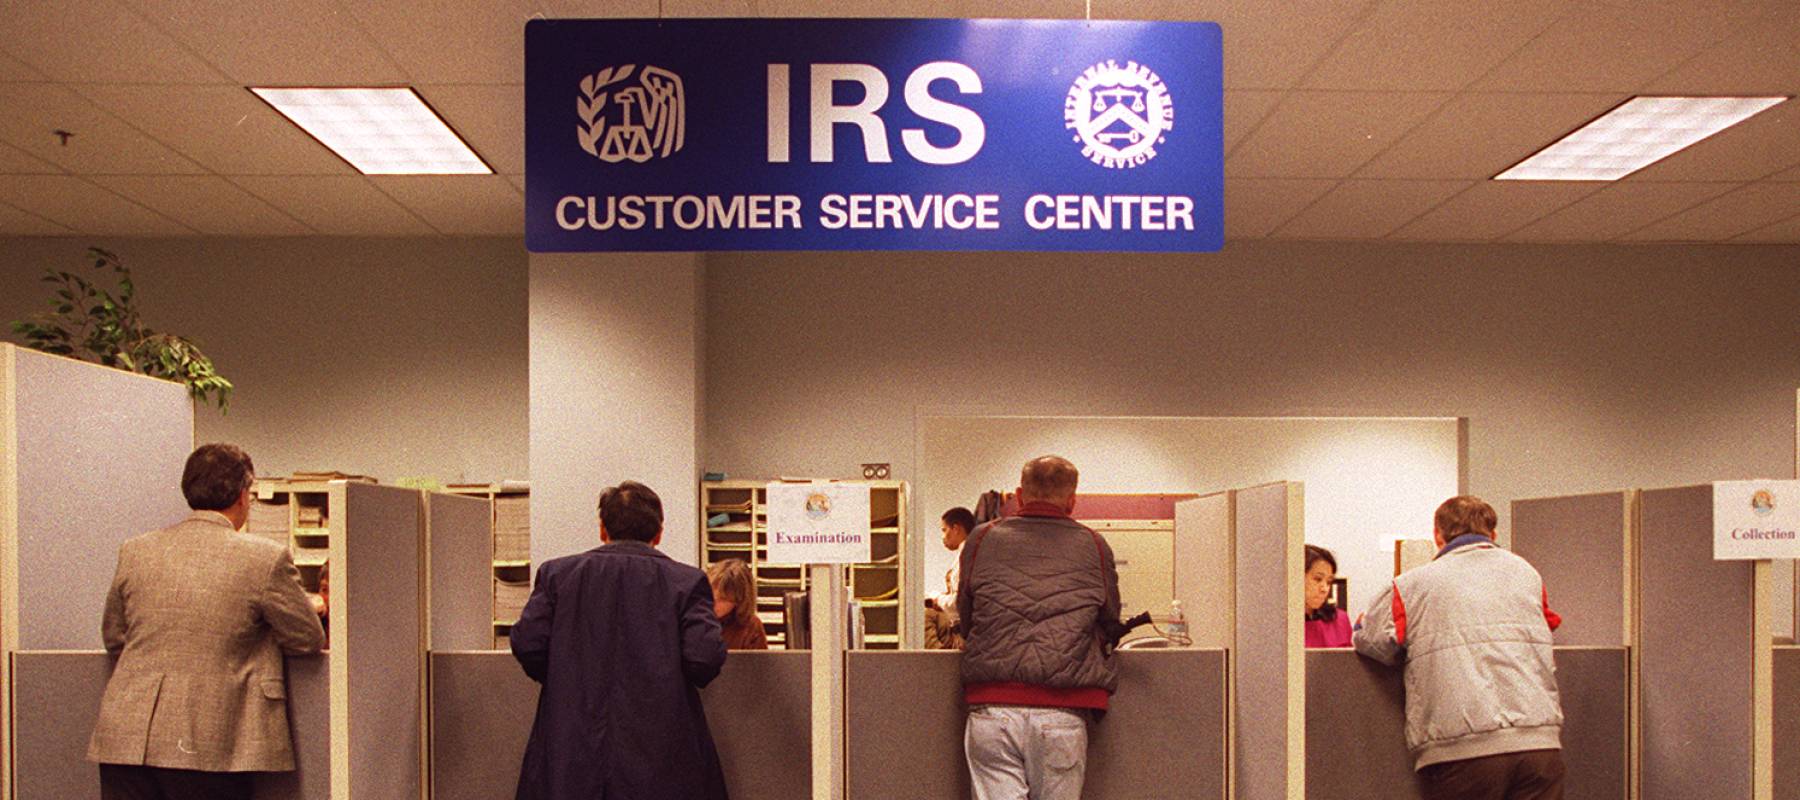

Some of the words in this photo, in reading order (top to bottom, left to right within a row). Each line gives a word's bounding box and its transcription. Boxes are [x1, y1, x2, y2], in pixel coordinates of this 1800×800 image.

[768, 62, 986, 165] IRS
[1064, 59, 1120, 130] INTERNAL
[1124, 60, 1175, 132] REVENUE
[1080, 145, 1158, 169] SERVICE
[556, 195, 803, 230] CUSTOMER
[819, 193, 1000, 230] SERVICE
[1024, 193, 1195, 230] CENTER
[1731, 527, 1796, 540] Collection
